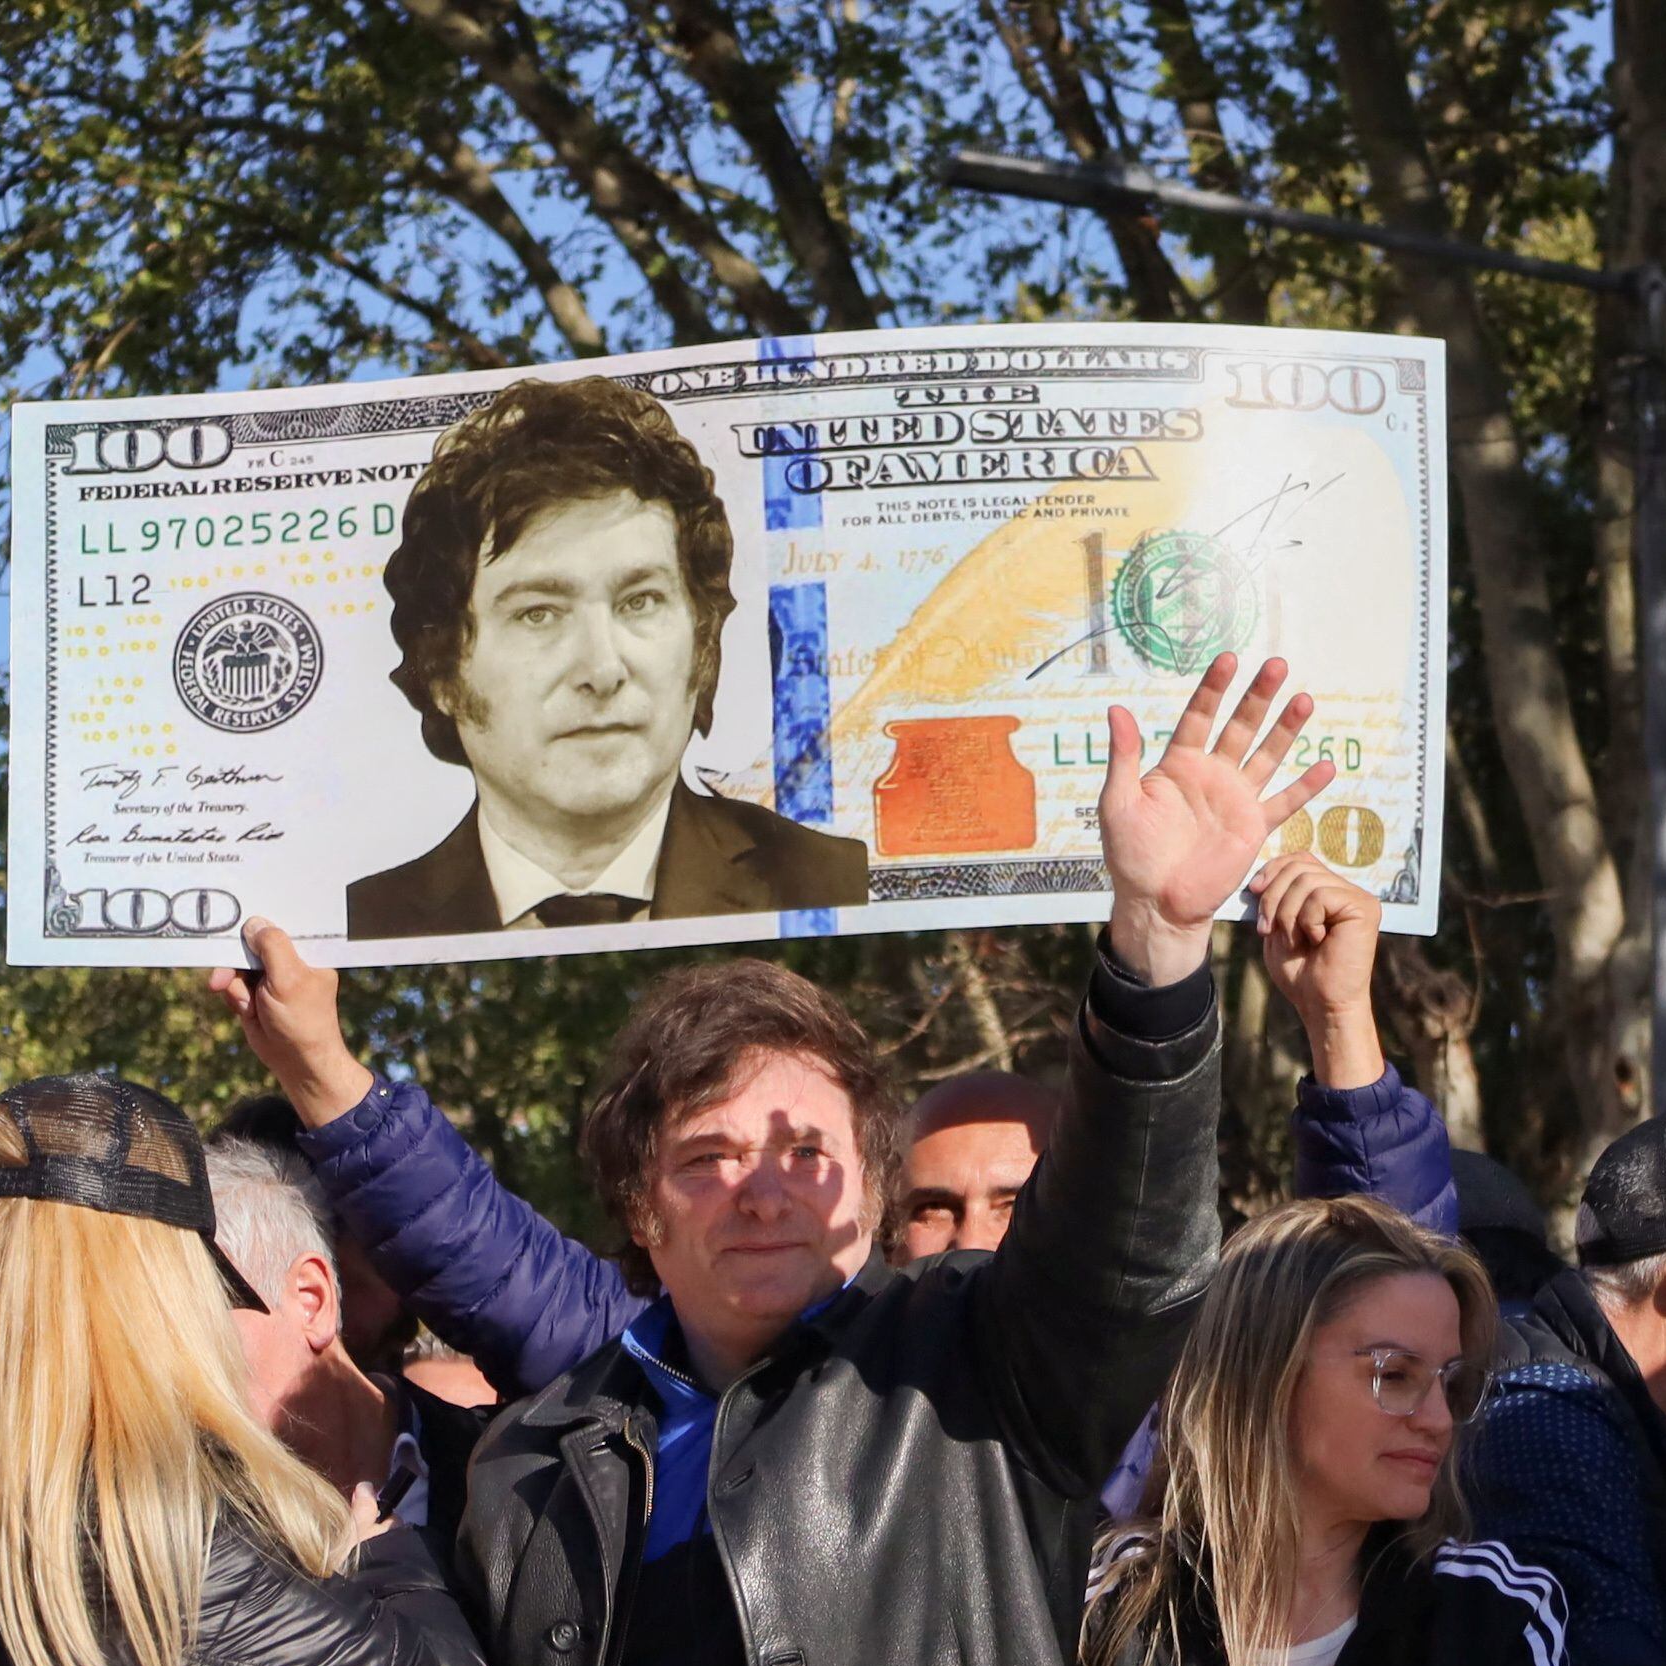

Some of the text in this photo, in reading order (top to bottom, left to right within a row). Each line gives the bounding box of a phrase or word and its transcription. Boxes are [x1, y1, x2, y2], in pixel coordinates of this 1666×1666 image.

[649, 347, 1193, 394] ONE HUNDRED DOLLARS
[1225, 361, 1386, 415] 100
[895, 384, 1040, 406] THE
[62, 423, 233, 475] 100
[731, 408, 1204, 457] UNITED STATES
[78, 480, 209, 502] FEDERAL
[211, 470, 352, 495] RESERVE
[784, 447, 1159, 493] OF AMERICA
[842, 505, 1131, 527] FOR ALL DEBTS, PUBLIC AND PRIVATE
[877, 494, 1096, 513] THIS NOTE IS LEGAL TENDER
[79, 574, 152, 607] L12
[191, 599, 301, 638] UNITED STATES
[180, 642, 315, 726] FEDERAL RESERVE SYSTEM
[113, 802, 161, 816] Secretary
[163, 801, 177, 815] of
[178, 802, 195, 814] the
[83, 851, 131, 865] Treasurer
[132, 851, 145, 866] of
[146, 851, 163, 865] the
[167, 851, 204, 865] United
[68, 888, 241, 934] 100
